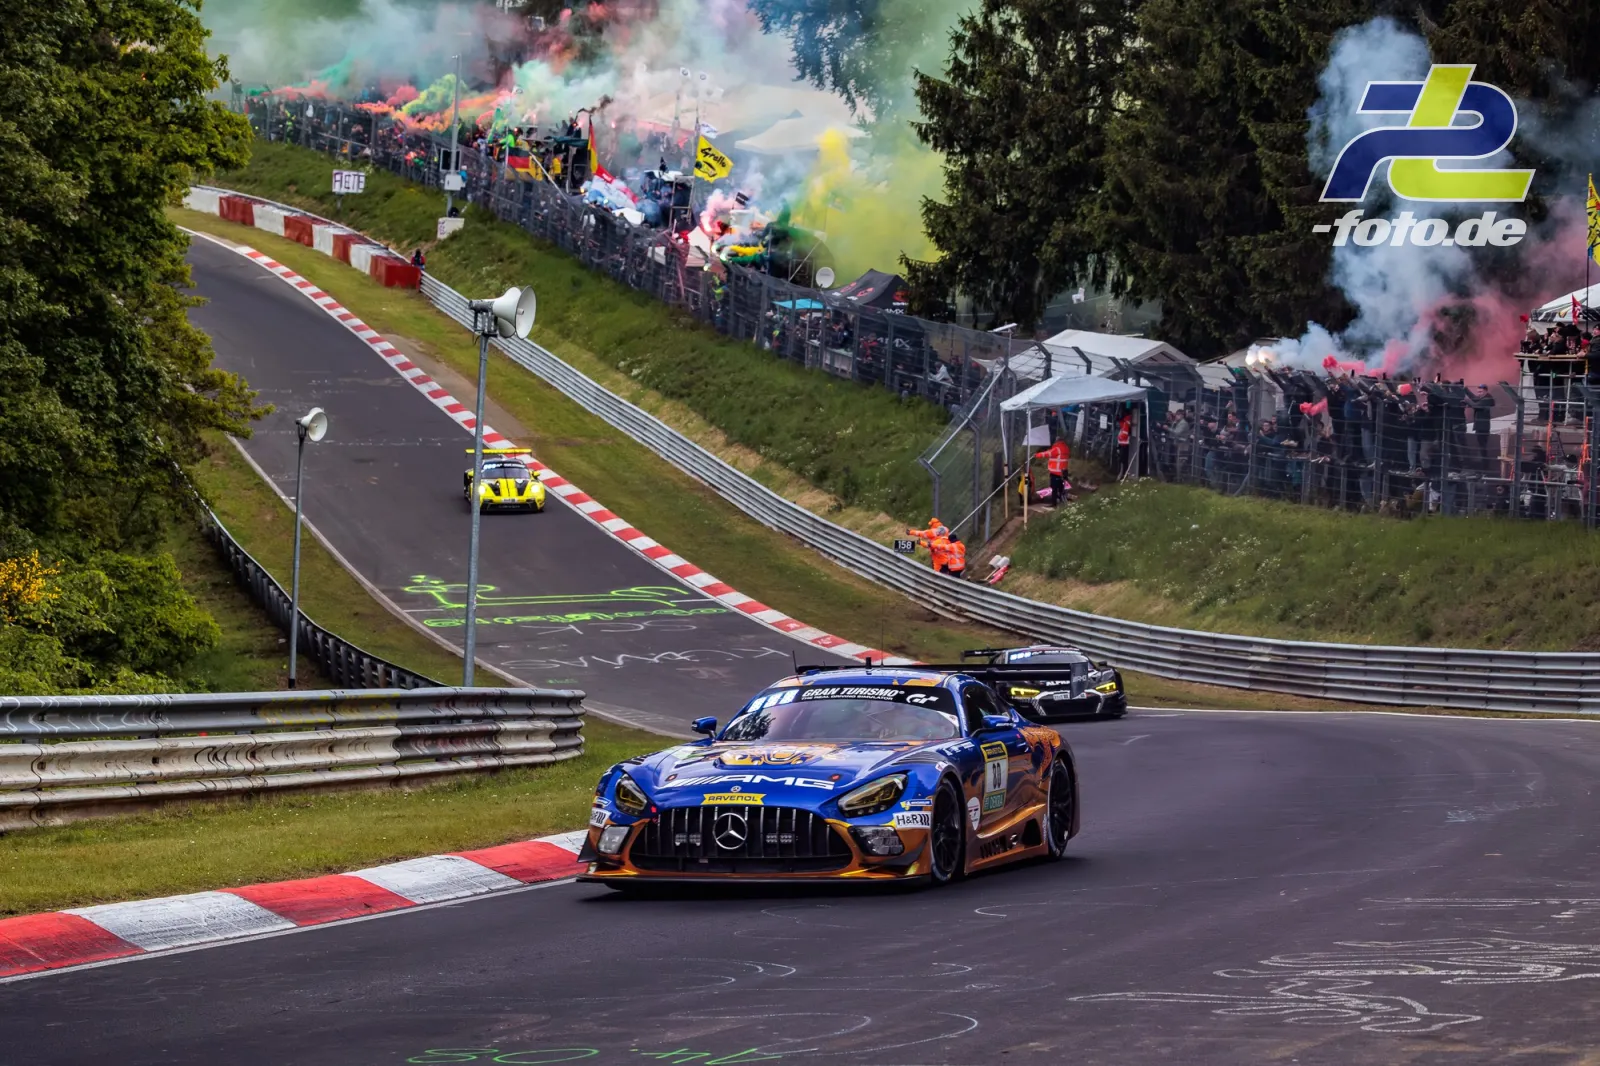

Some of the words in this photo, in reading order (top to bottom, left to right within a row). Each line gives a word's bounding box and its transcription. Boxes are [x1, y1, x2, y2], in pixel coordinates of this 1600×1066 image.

[897, 540, 912, 550] 158
[802, 686, 837, 698] GRAN
[714, 774, 836, 790] AMG
[707, 794, 759, 803] RAVENOL
[896, 814, 919, 826] H&R
